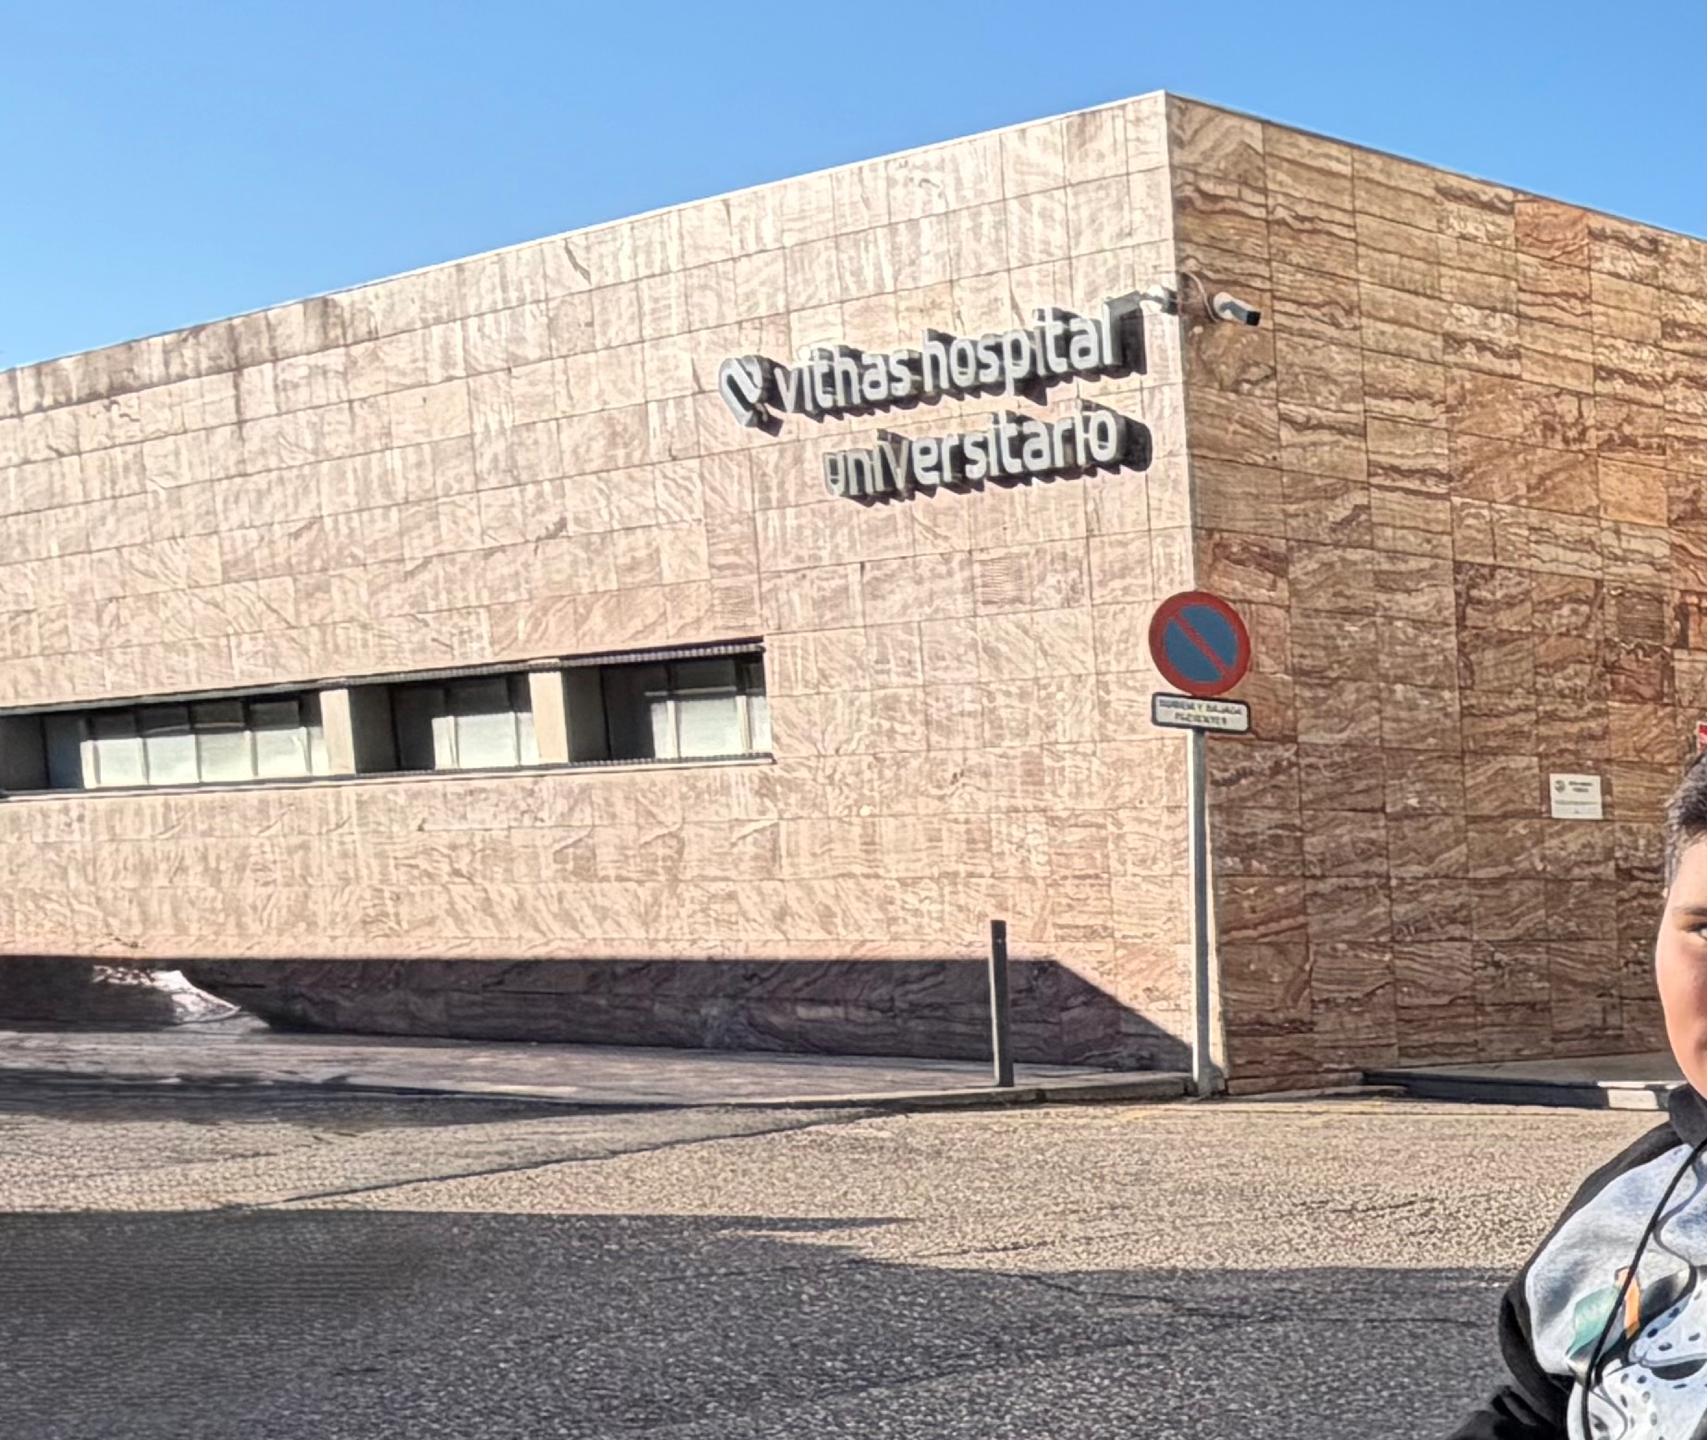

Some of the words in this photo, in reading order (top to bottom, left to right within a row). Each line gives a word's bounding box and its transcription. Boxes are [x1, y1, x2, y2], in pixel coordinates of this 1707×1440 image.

[776, 344, 912, 413] vithas
[922, 300, 1115, 396] hospital
[823, 408, 1120, 497] universitario
